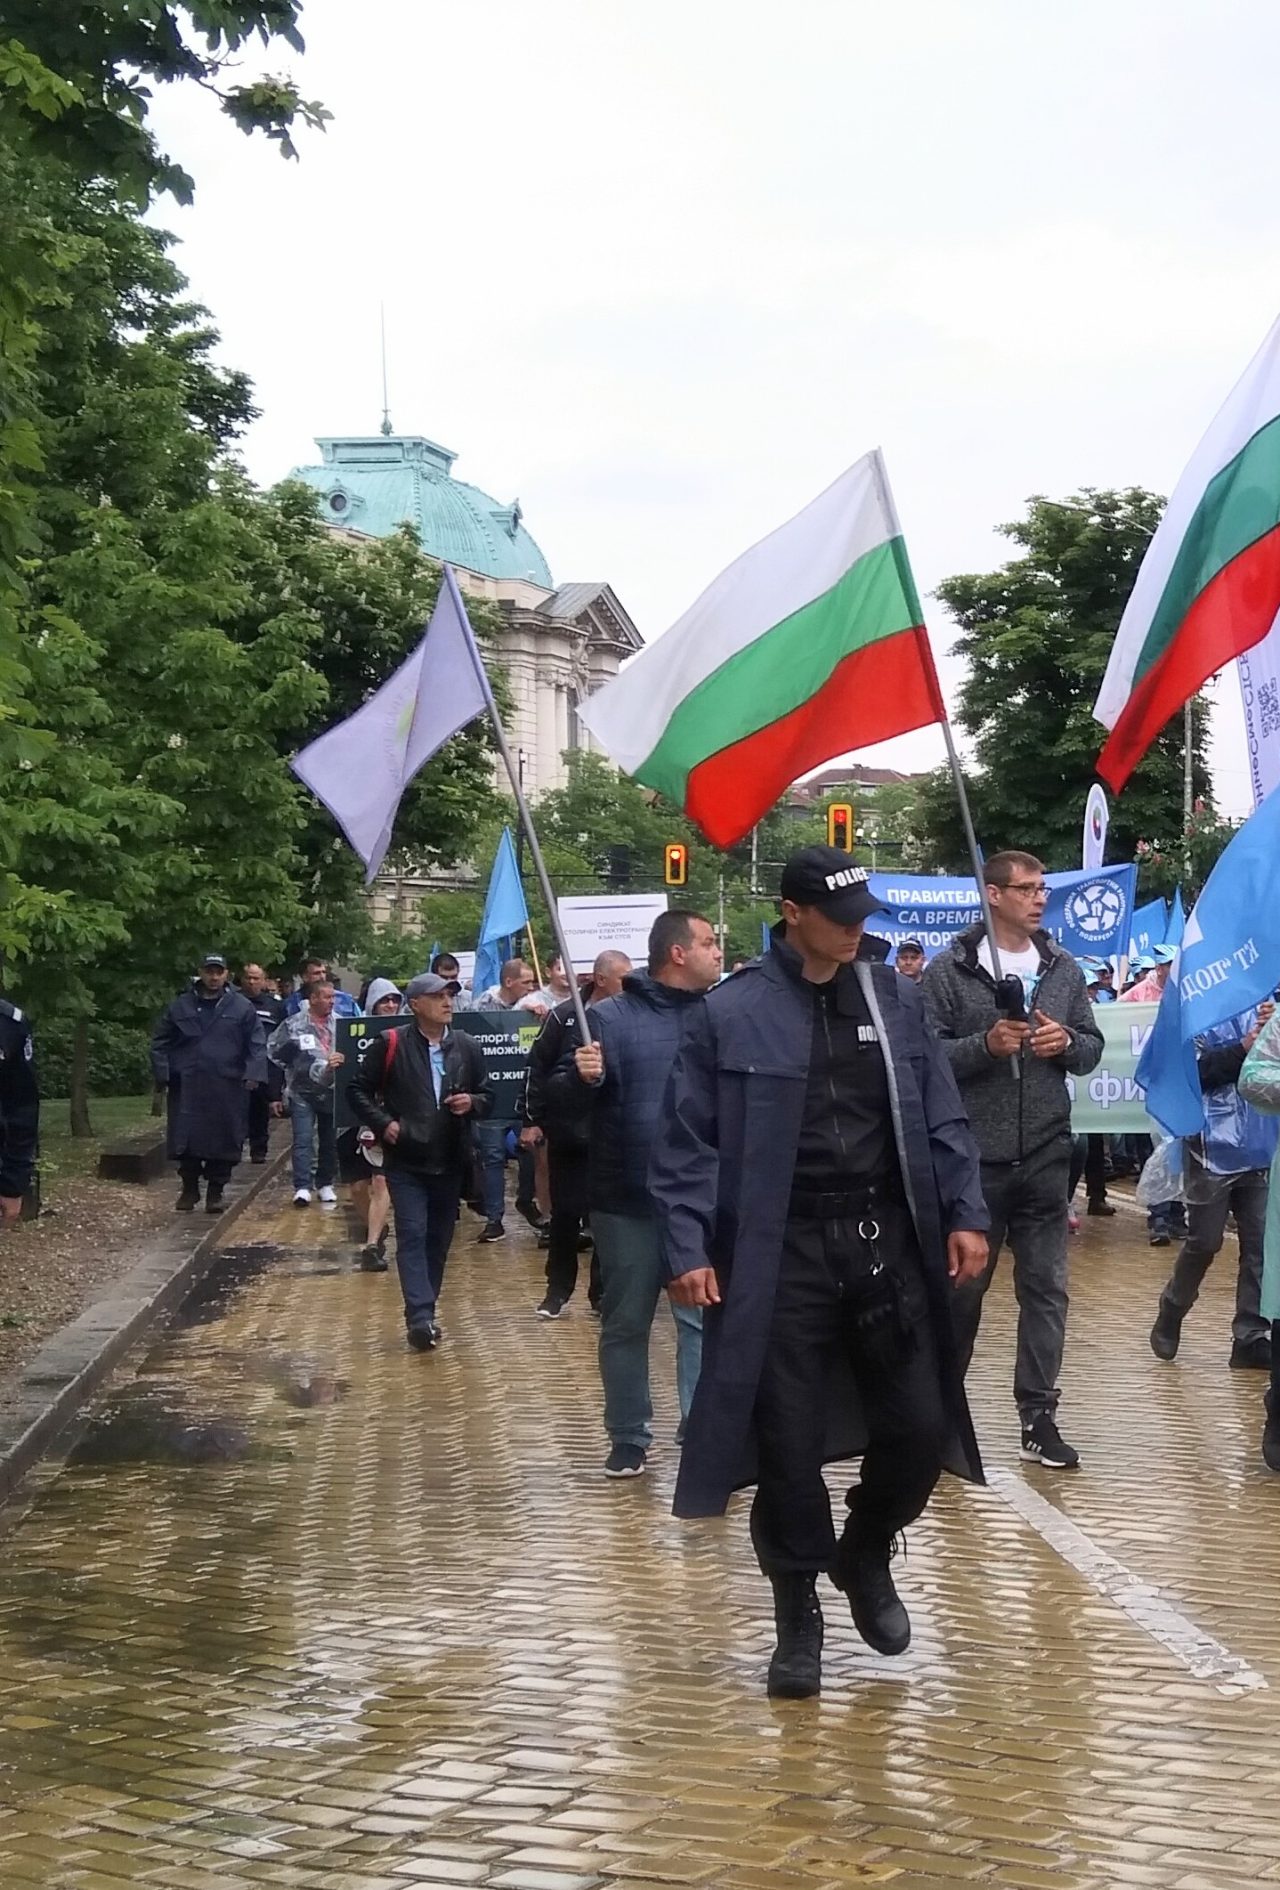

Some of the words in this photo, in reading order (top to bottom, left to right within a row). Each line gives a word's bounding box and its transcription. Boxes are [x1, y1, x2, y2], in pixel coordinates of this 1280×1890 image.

[824, 866, 870, 891] POLICE
[897, 910, 920, 924] СА
[1078, 930, 1114, 942] ПОДКРЕПА
